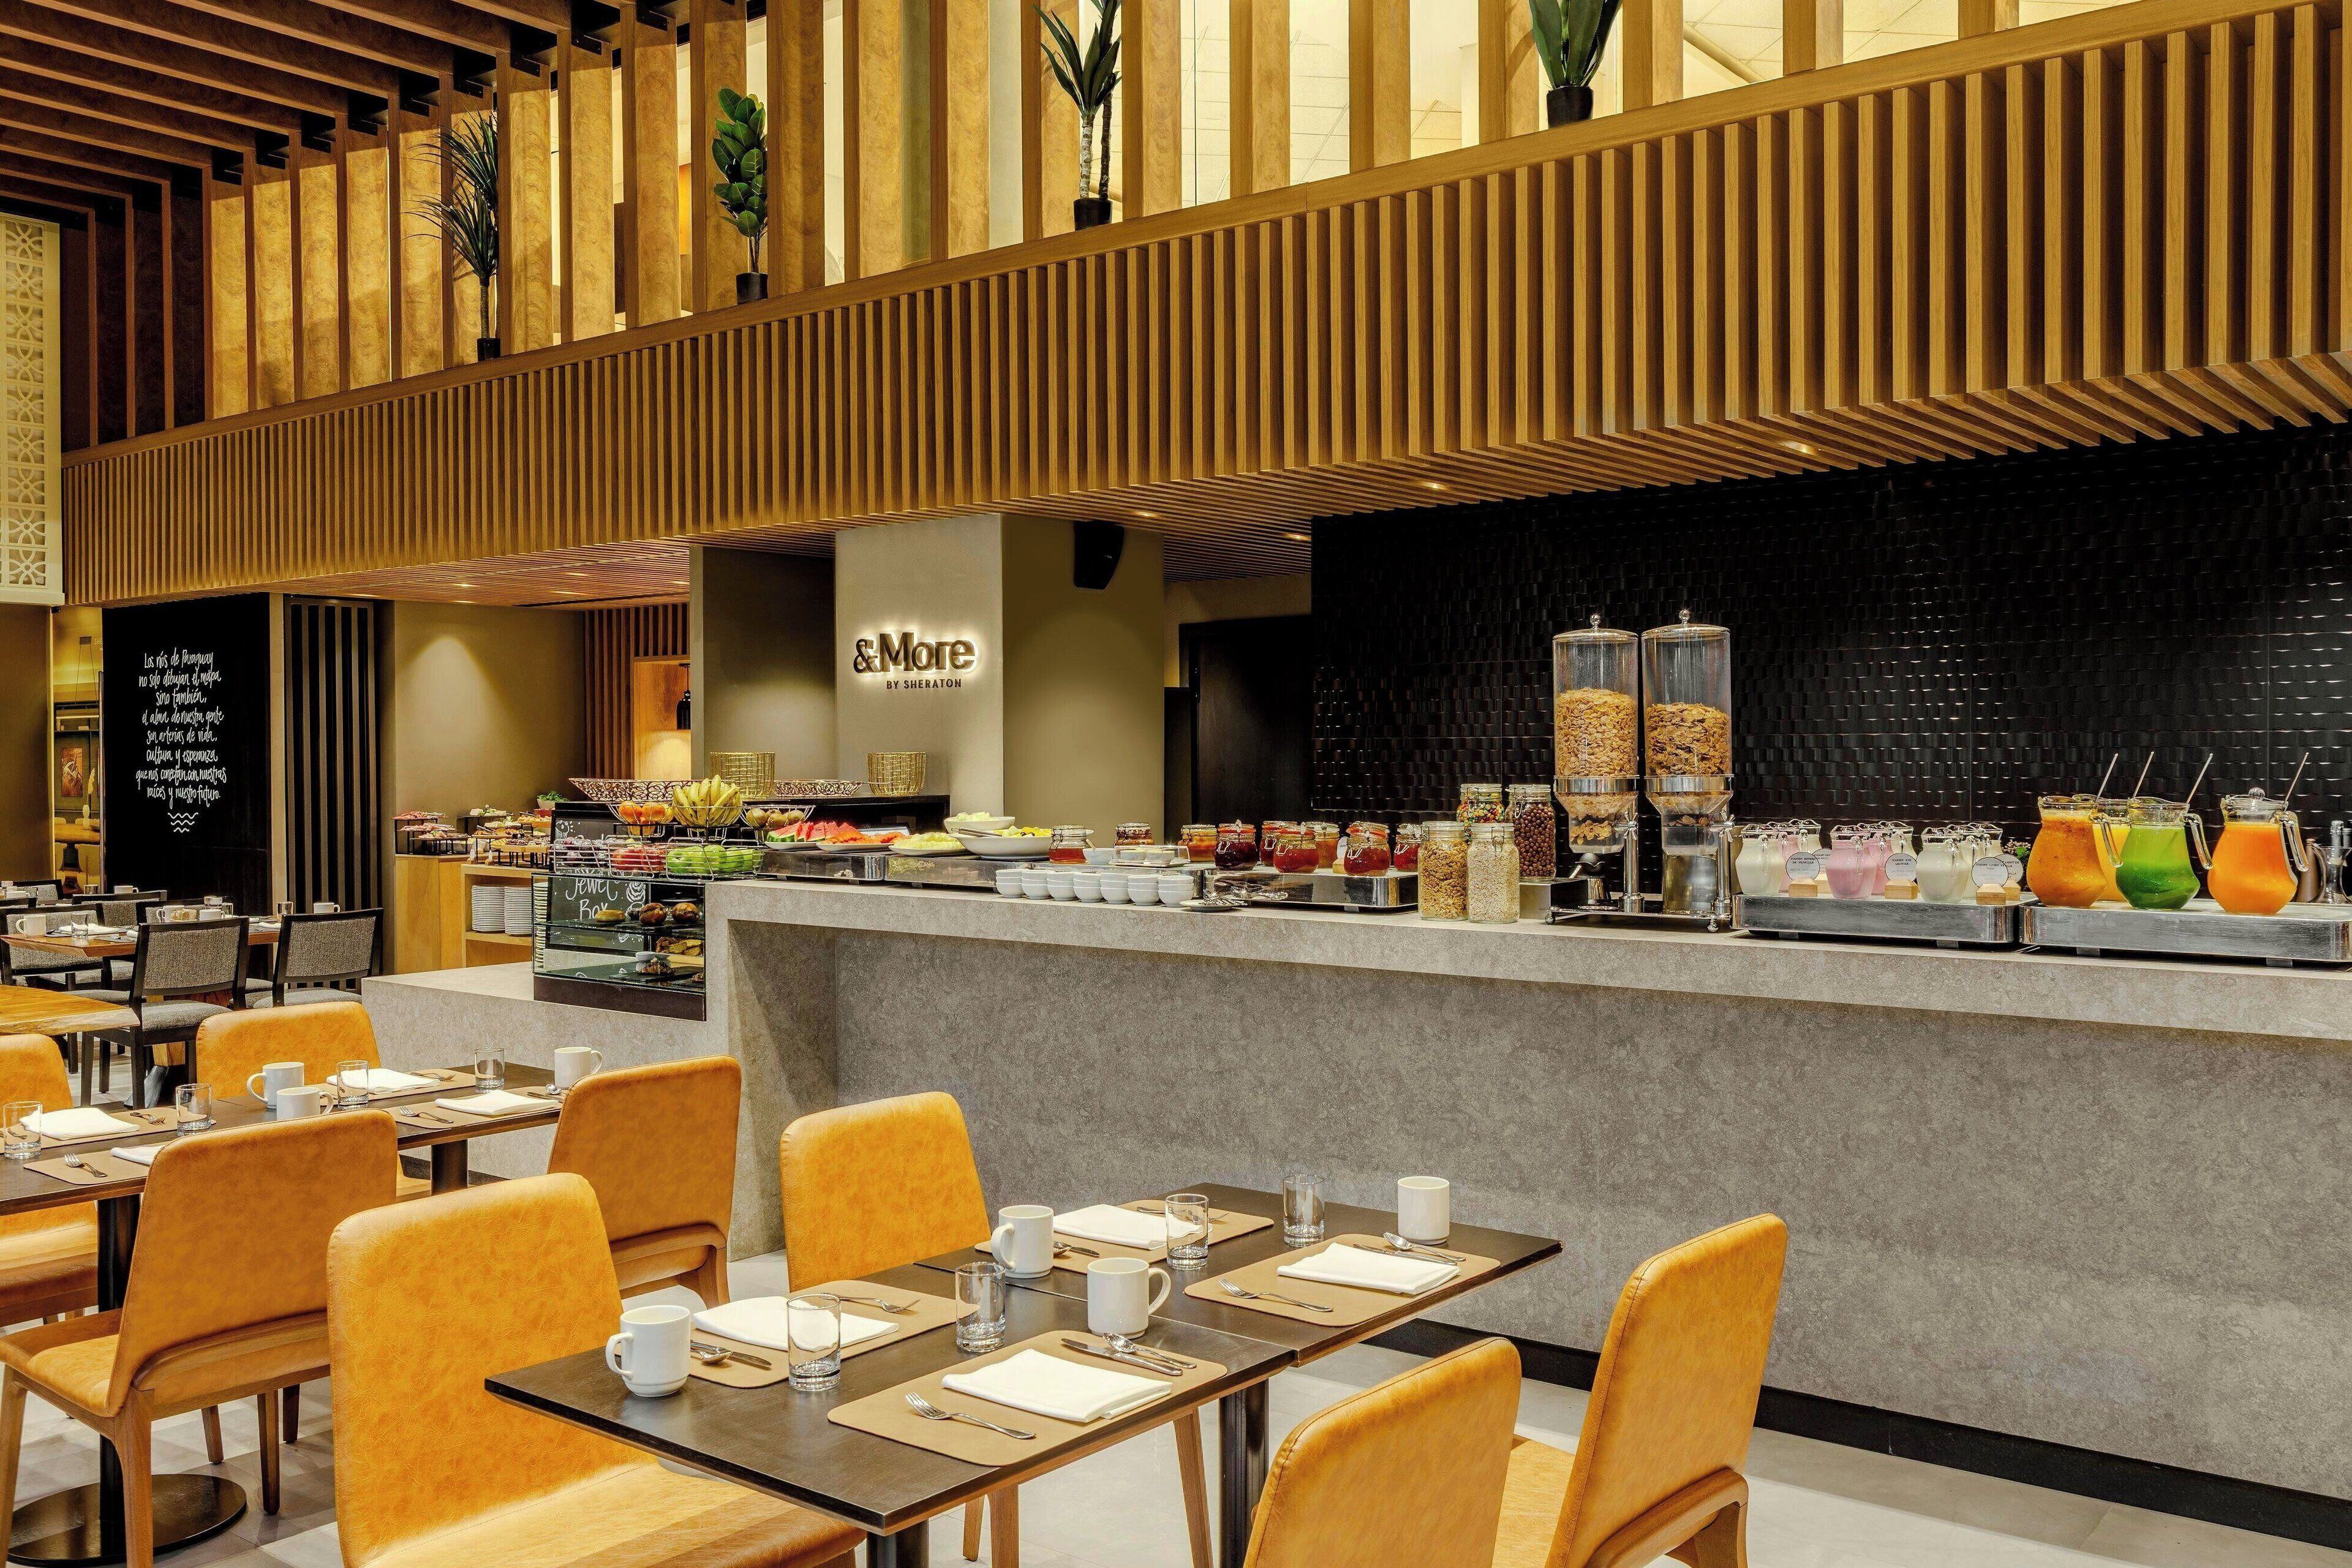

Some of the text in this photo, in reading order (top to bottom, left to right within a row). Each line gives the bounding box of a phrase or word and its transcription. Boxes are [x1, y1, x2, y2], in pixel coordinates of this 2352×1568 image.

[144, 647, 214, 673] Los ríos de Paraguay
[853, 632, 976, 673] &More
[138, 668, 222, 690] no solo dibujan el mapa
[886, 679, 962, 690] BY SHERATON
[156, 687, 207, 708] sino también,
[141, 706, 224, 729] el alma de nuestra gente
[146, 730, 159, 744] son
[159, 726, 184, 744] arterias
[186, 726, 195, 743] de
[146, 745, 218, 768] cultura y esperanza
[135, 765, 227, 790] que nos conectan con nuestras
[147, 783, 221, 809] raíces y nuestro futuro.
[579, 899, 608, 920] Box
